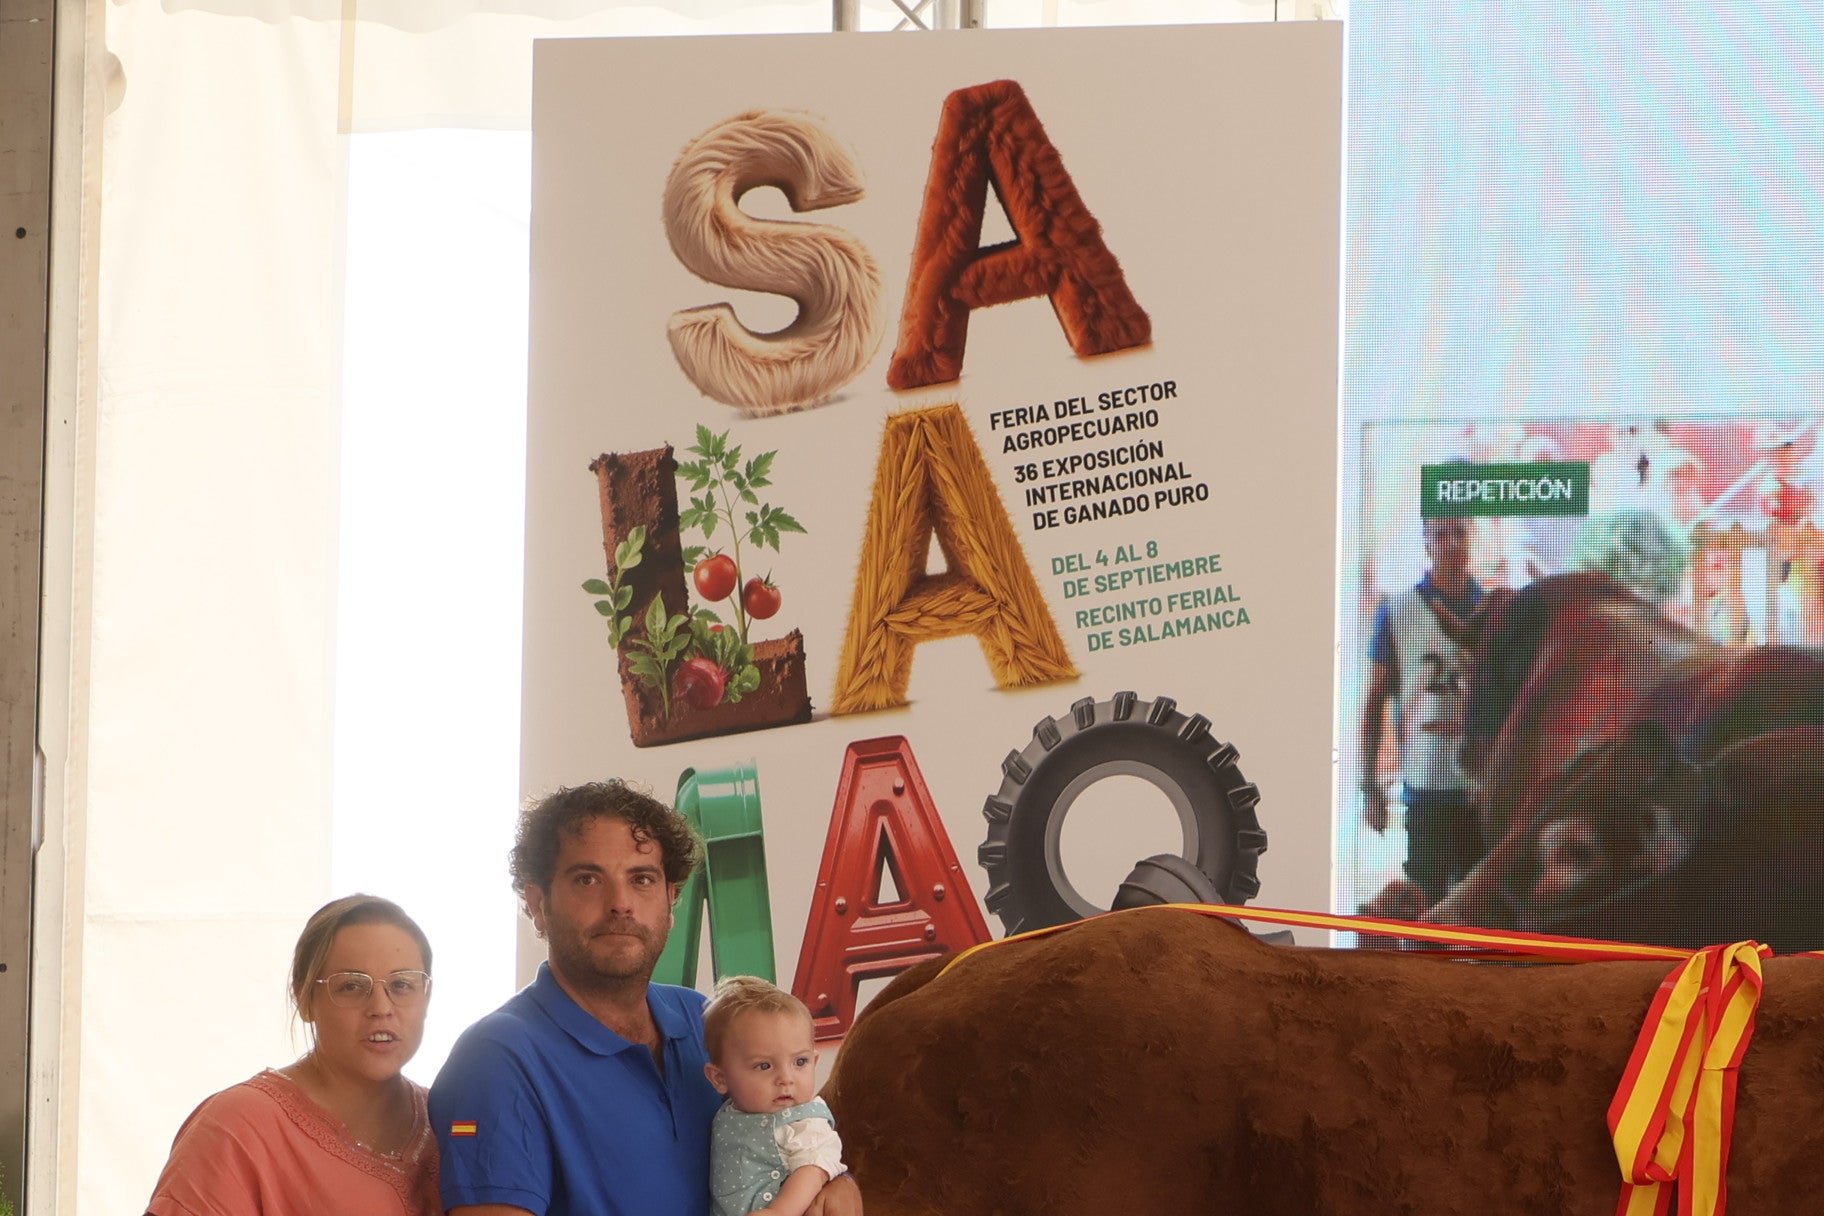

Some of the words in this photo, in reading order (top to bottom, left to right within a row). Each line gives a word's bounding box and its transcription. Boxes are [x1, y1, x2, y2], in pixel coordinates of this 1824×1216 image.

[662, 79, 1153, 418] SA
[990, 404, 1049, 431] FERIA
[1054, 397, 1094, 419] DEL
[1098, 380, 1177, 411] SECTOR
[1003, 409, 1159, 454] AGROPECUARIO
[1014, 463, 1038, 484] 36
[1042, 439, 1164, 478] EXPOSICIÓN
[1025, 462, 1192, 507] INTERNACIONAL
[1033, 509, 1060, 531] DE
[1064, 494, 1150, 525] GANADO
[1155, 481, 1210, 509] PURO
[1437, 477, 1572, 501] REPETICIÓN
[588, 403, 1082, 748] LA
[1051, 553, 1091, 576] DEL
[1095, 549, 1109, 567] 4
[1115, 544, 1142, 565] AL
[1146, 540, 1158, 559] 8
[1063, 577, 1090, 599] DE
[1094, 554, 1222, 593] SEPTIEMBRE
[1075, 597, 1162, 629] RECINTO
[1167, 584, 1241, 613] FERIAL
[1087, 631, 1114, 652] DE
[1118, 607, 1251, 647] SALAMANCA
